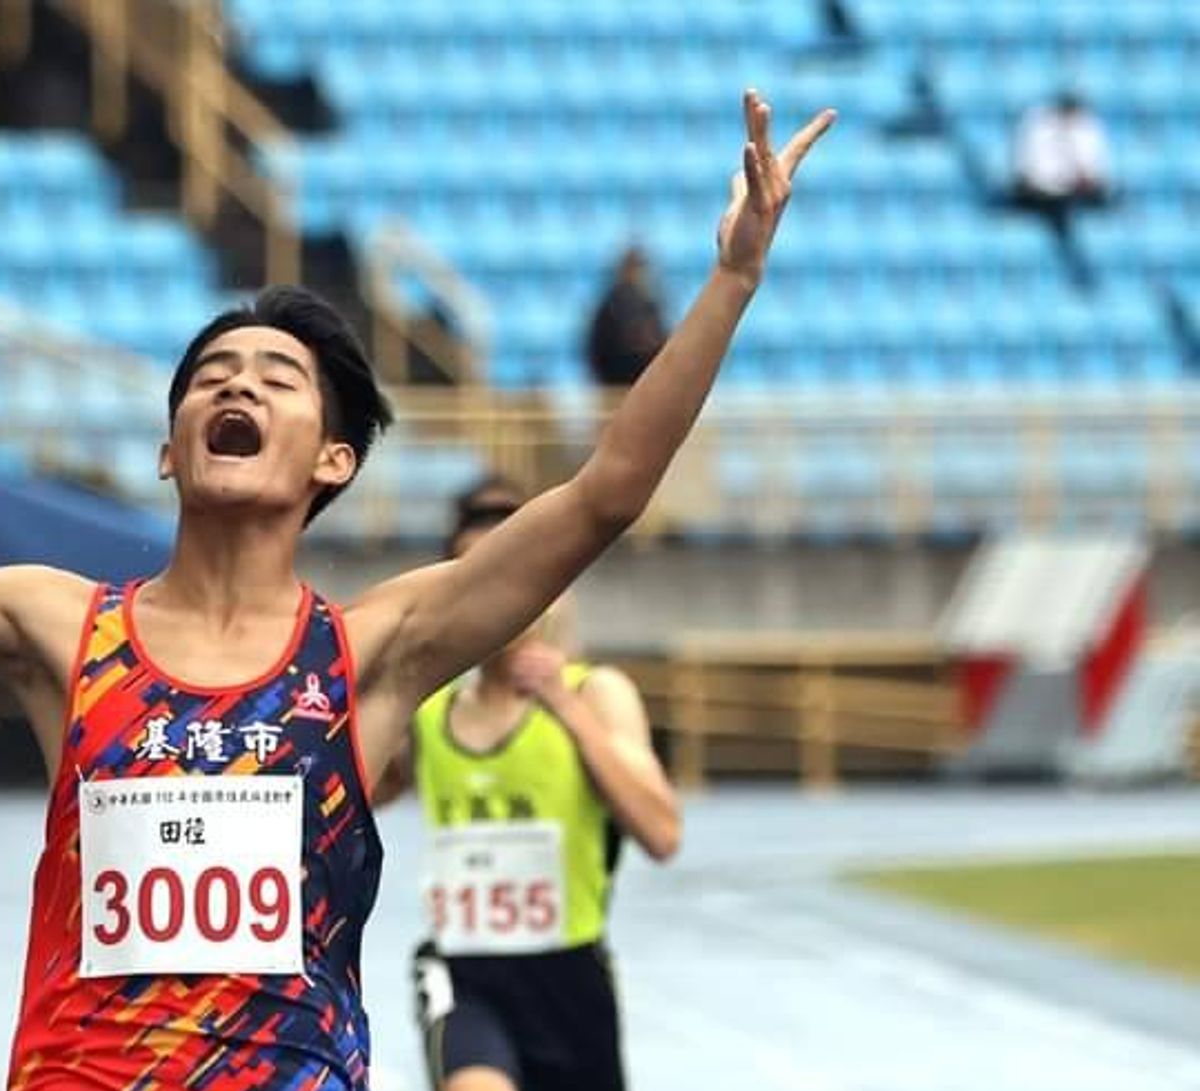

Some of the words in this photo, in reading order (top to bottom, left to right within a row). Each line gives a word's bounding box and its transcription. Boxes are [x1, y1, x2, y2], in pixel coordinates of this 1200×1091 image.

[135, 717, 283, 762] 基隆市
[93, 866, 291, 946] 3009
